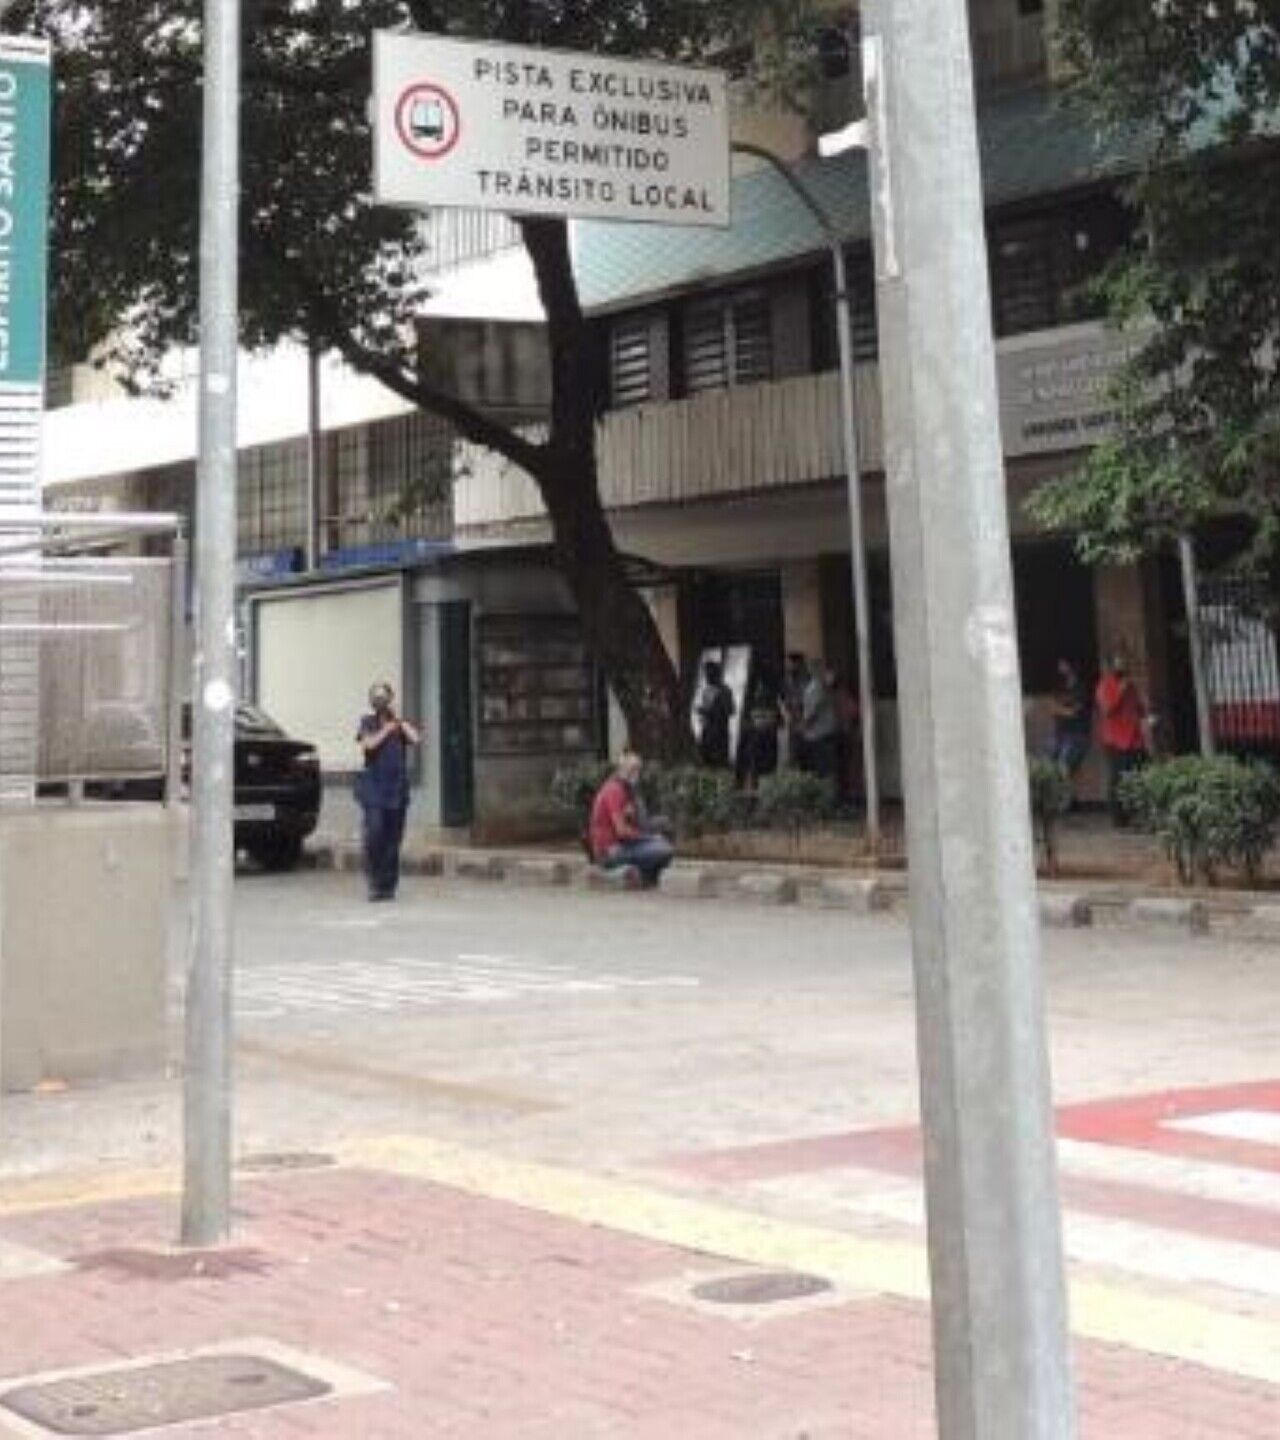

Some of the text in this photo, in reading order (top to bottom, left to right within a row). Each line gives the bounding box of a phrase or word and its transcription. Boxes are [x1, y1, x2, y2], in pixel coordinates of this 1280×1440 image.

[473, 57, 711, 105] PISTA EXCLUSIVA
[503, 98, 689, 139] PARA ÔNIBUS
[525, 137, 670, 172] PERMITIDO
[476, 166, 714, 213] TRÂNSITO LOCAL
